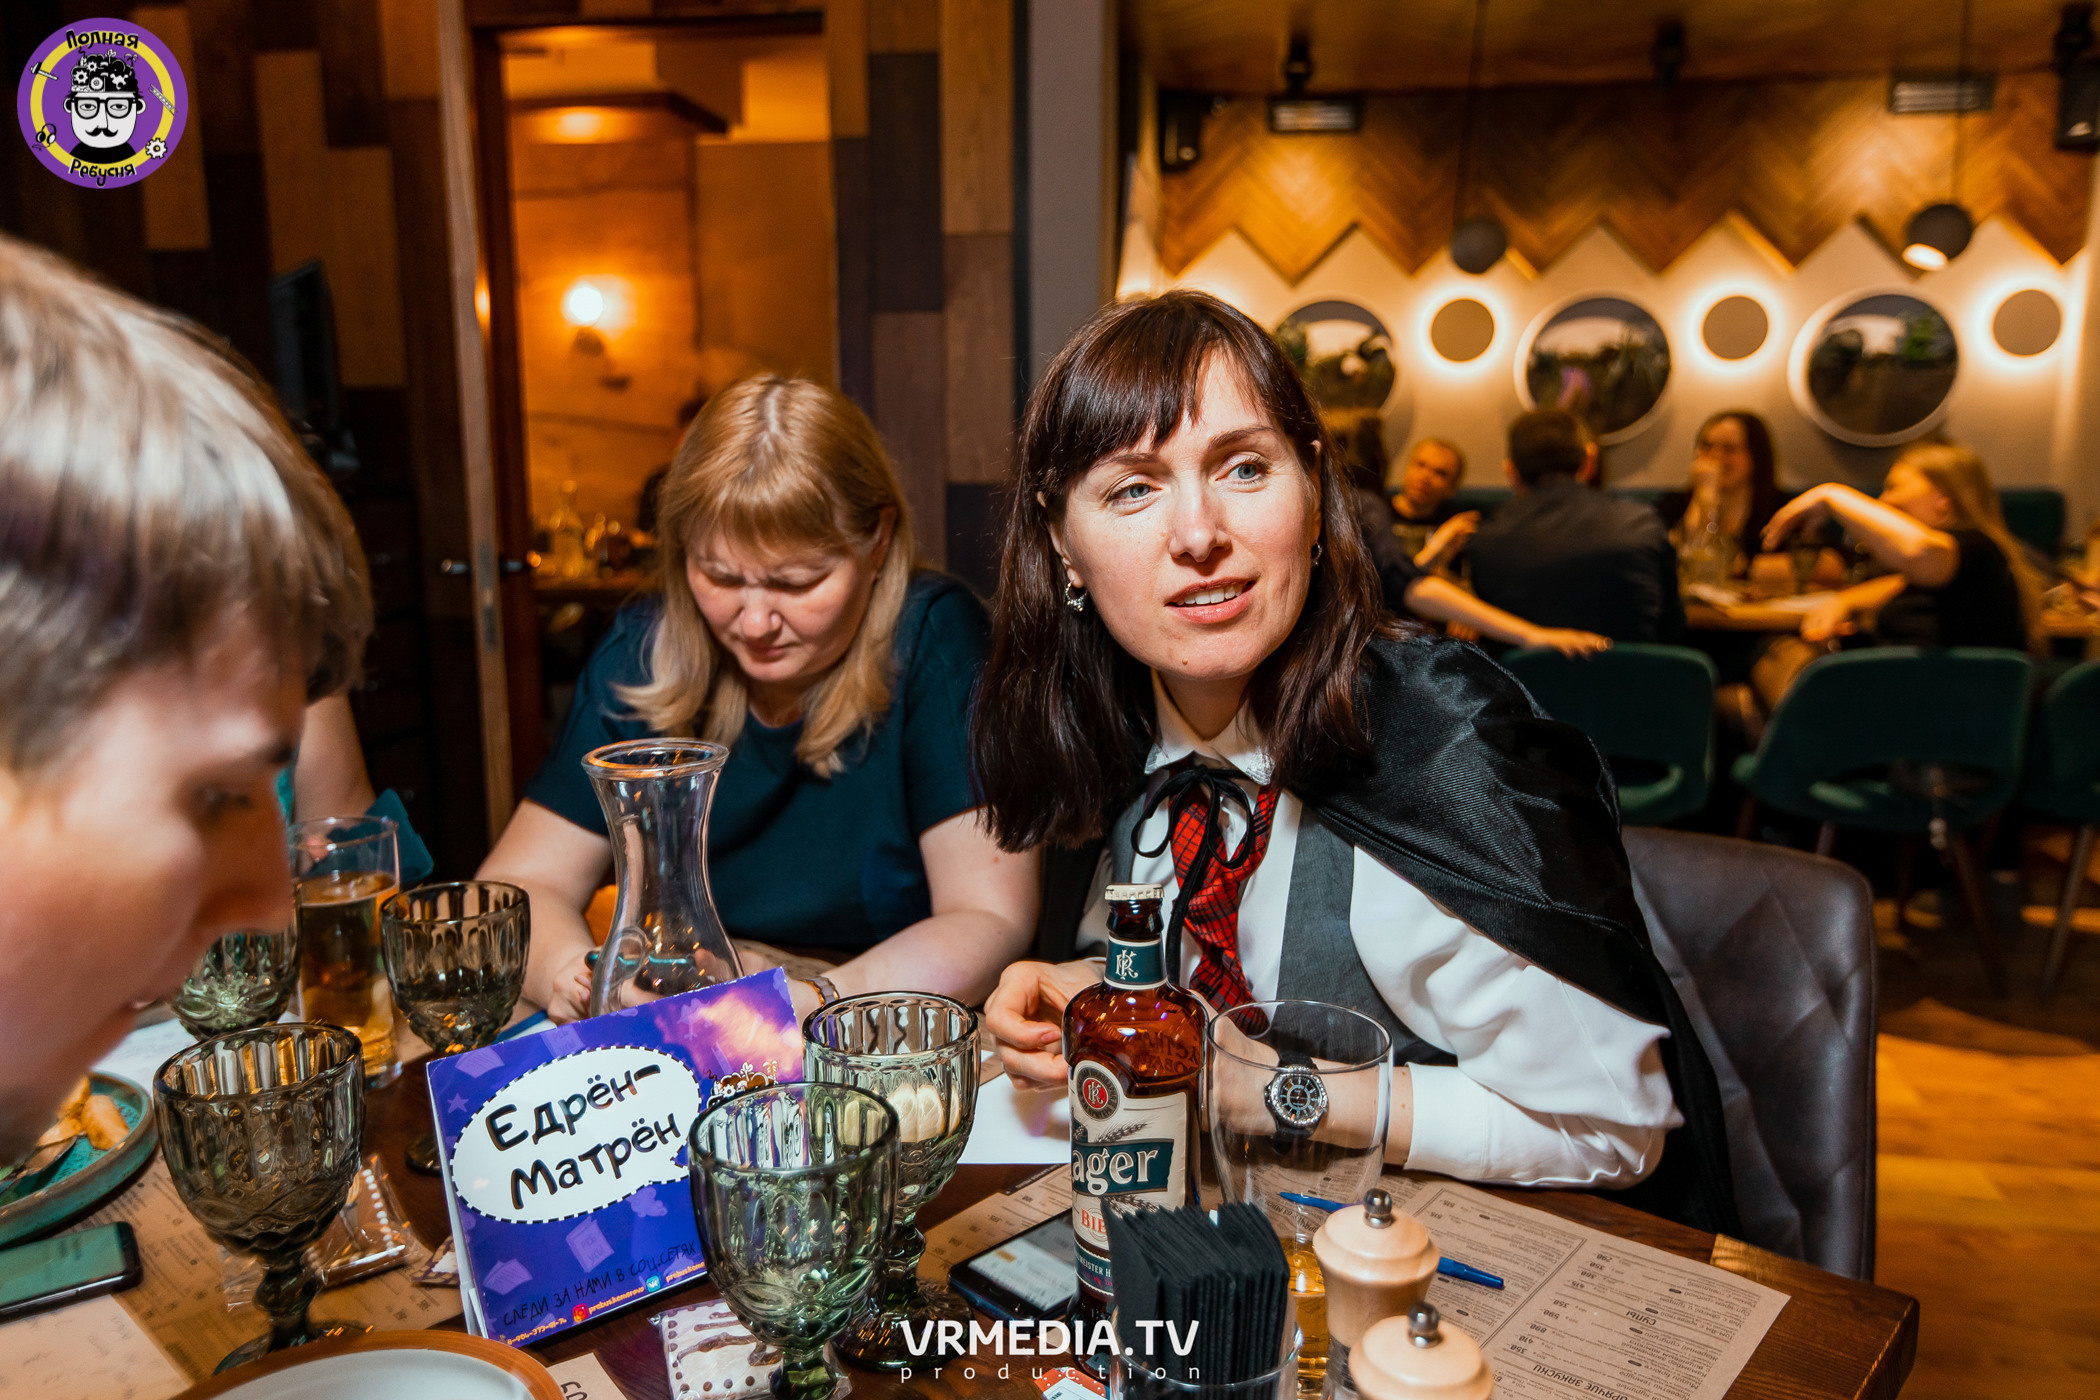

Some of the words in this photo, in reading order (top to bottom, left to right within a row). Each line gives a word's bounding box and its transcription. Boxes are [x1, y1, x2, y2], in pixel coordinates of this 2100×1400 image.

[485, 1063, 661, 1151] Едрён-
[510, 1112, 682, 1210] Матрён
[1072, 1148, 1159, 1195] ager
[1081, 1208, 1107, 1235] BIE
[504, 1296, 549, 1326] СЛЕДИ
[553, 1288, 571, 1308] ЗА
[574, 1272, 612, 1299] НАМИ
[615, 1268, 625, 1283] В
[1626, 1310, 1656, 1326] СУПЫ
[1532, 1364, 1583, 1390] ЗАКУСКИ
[1584, 1382, 1629, 1400] ОРЯЧИЕ
